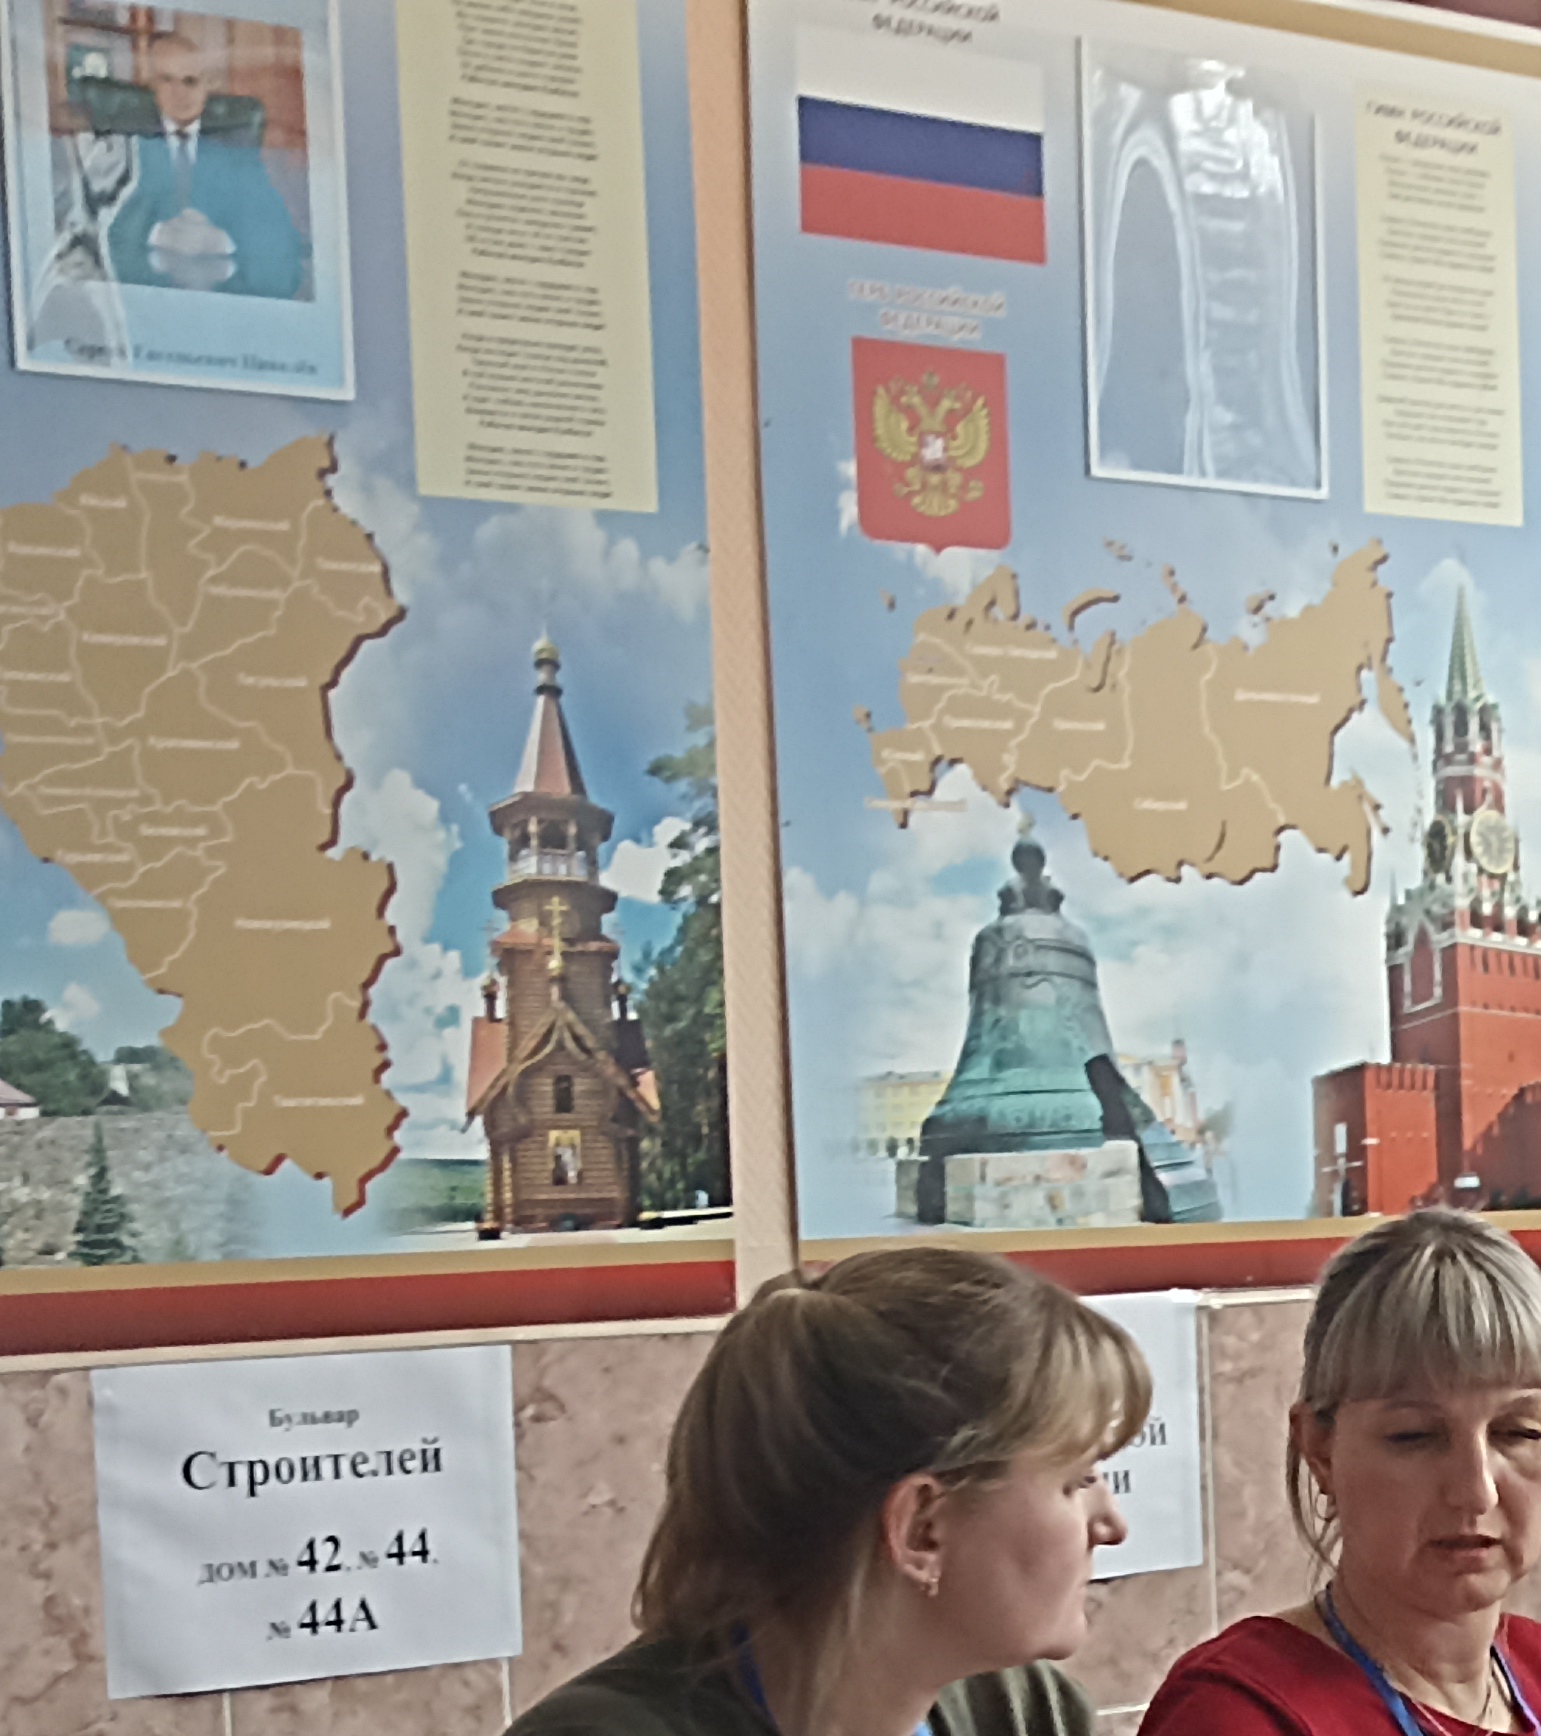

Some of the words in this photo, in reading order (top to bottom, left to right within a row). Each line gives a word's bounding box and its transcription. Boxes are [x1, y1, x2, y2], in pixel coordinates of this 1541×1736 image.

[267, 1406, 361, 1433] Бульвар
[181, 1435, 444, 1498] Строителей
[197, 1559, 258, 1587] дом
[297, 1596, 380, 1636] 44А
